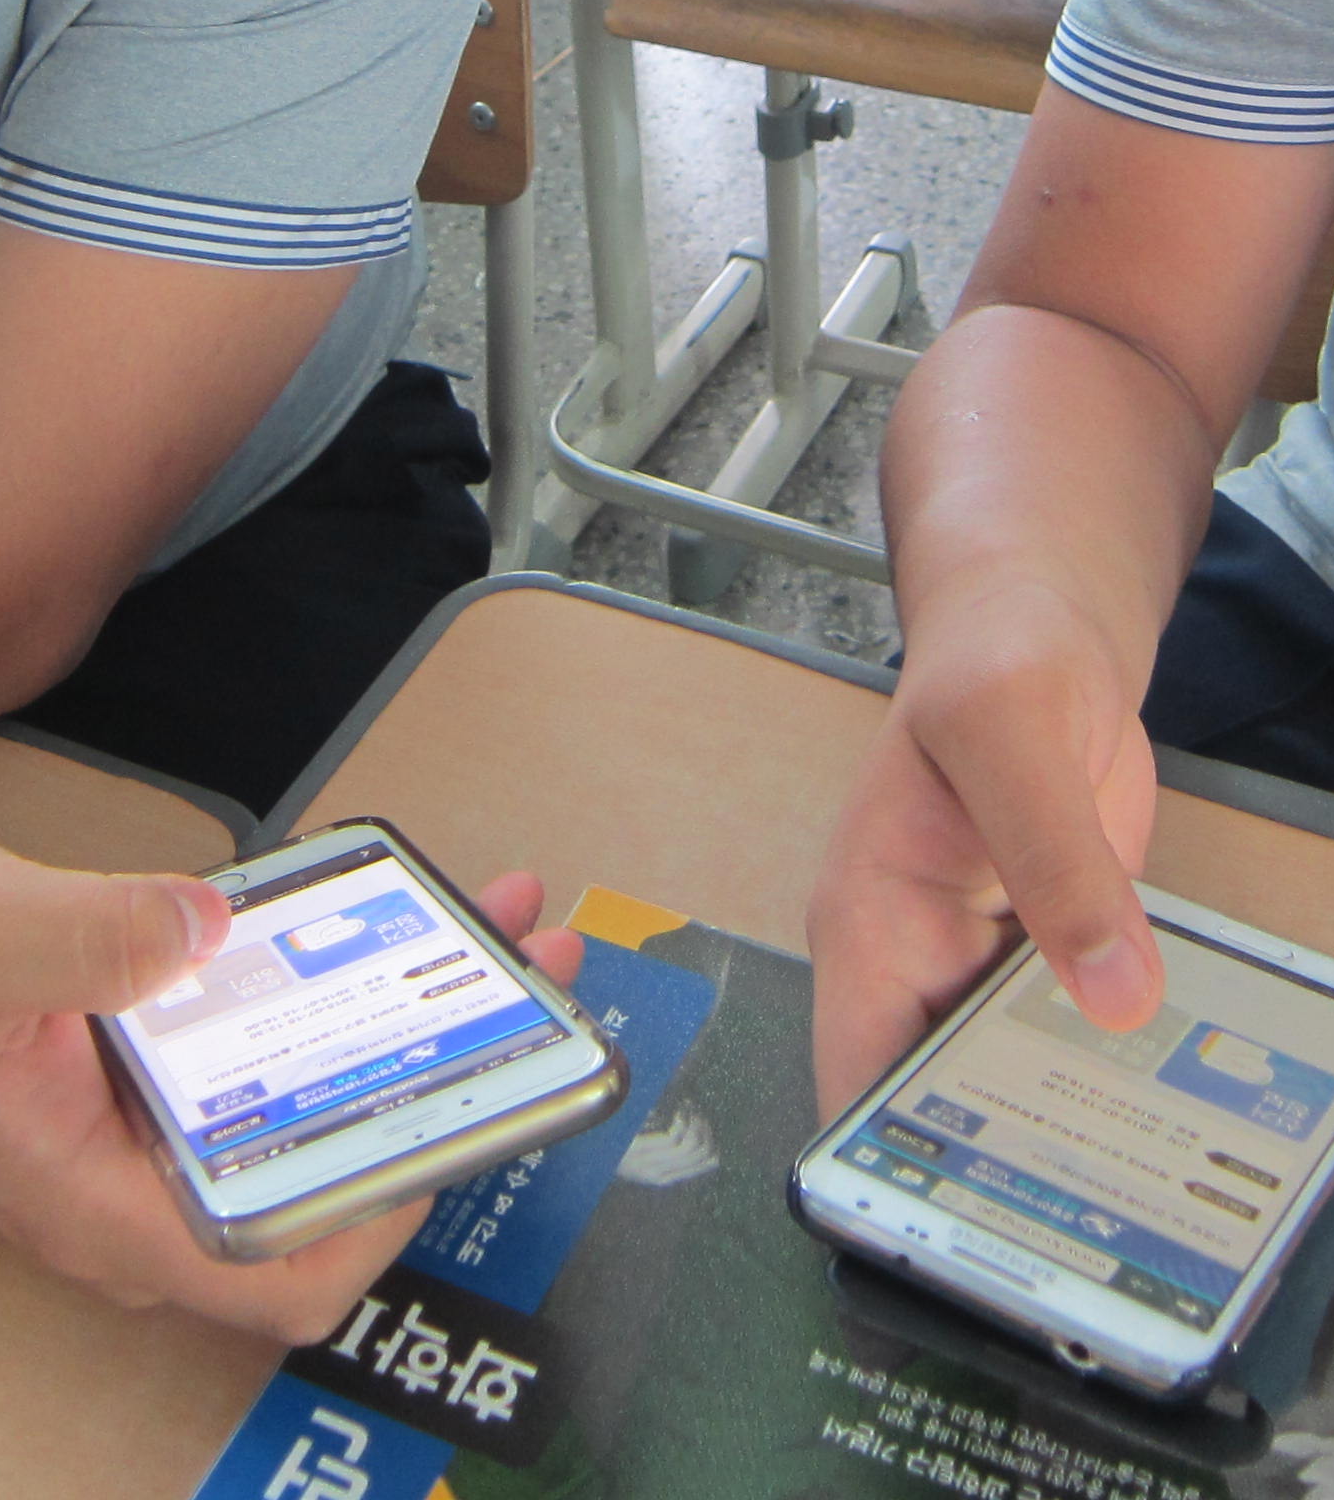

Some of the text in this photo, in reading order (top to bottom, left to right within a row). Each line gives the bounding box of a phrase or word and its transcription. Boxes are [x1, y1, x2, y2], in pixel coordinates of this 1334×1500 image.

[371, 910, 419, 937] 정보
[378, 918, 428, 946] 선거
[456, 1215, 499, 1266] 내신
[809, 1348, 847, 1378] 수록
[848, 1366, 887, 1395] 문제
[890, 1381, 946, 1414] 수준의
[878, 1403, 916, 1432] 정리
[923, 1416, 960, 1447] 내용
[950, 1404, 1007, 1440] 유형과
[822, 1414, 1011, 1500] 과학탐구 기본서
[963, 1432, 1041, 1478] 체계적인
[1011, 1424, 1069, 1462] 다양한
